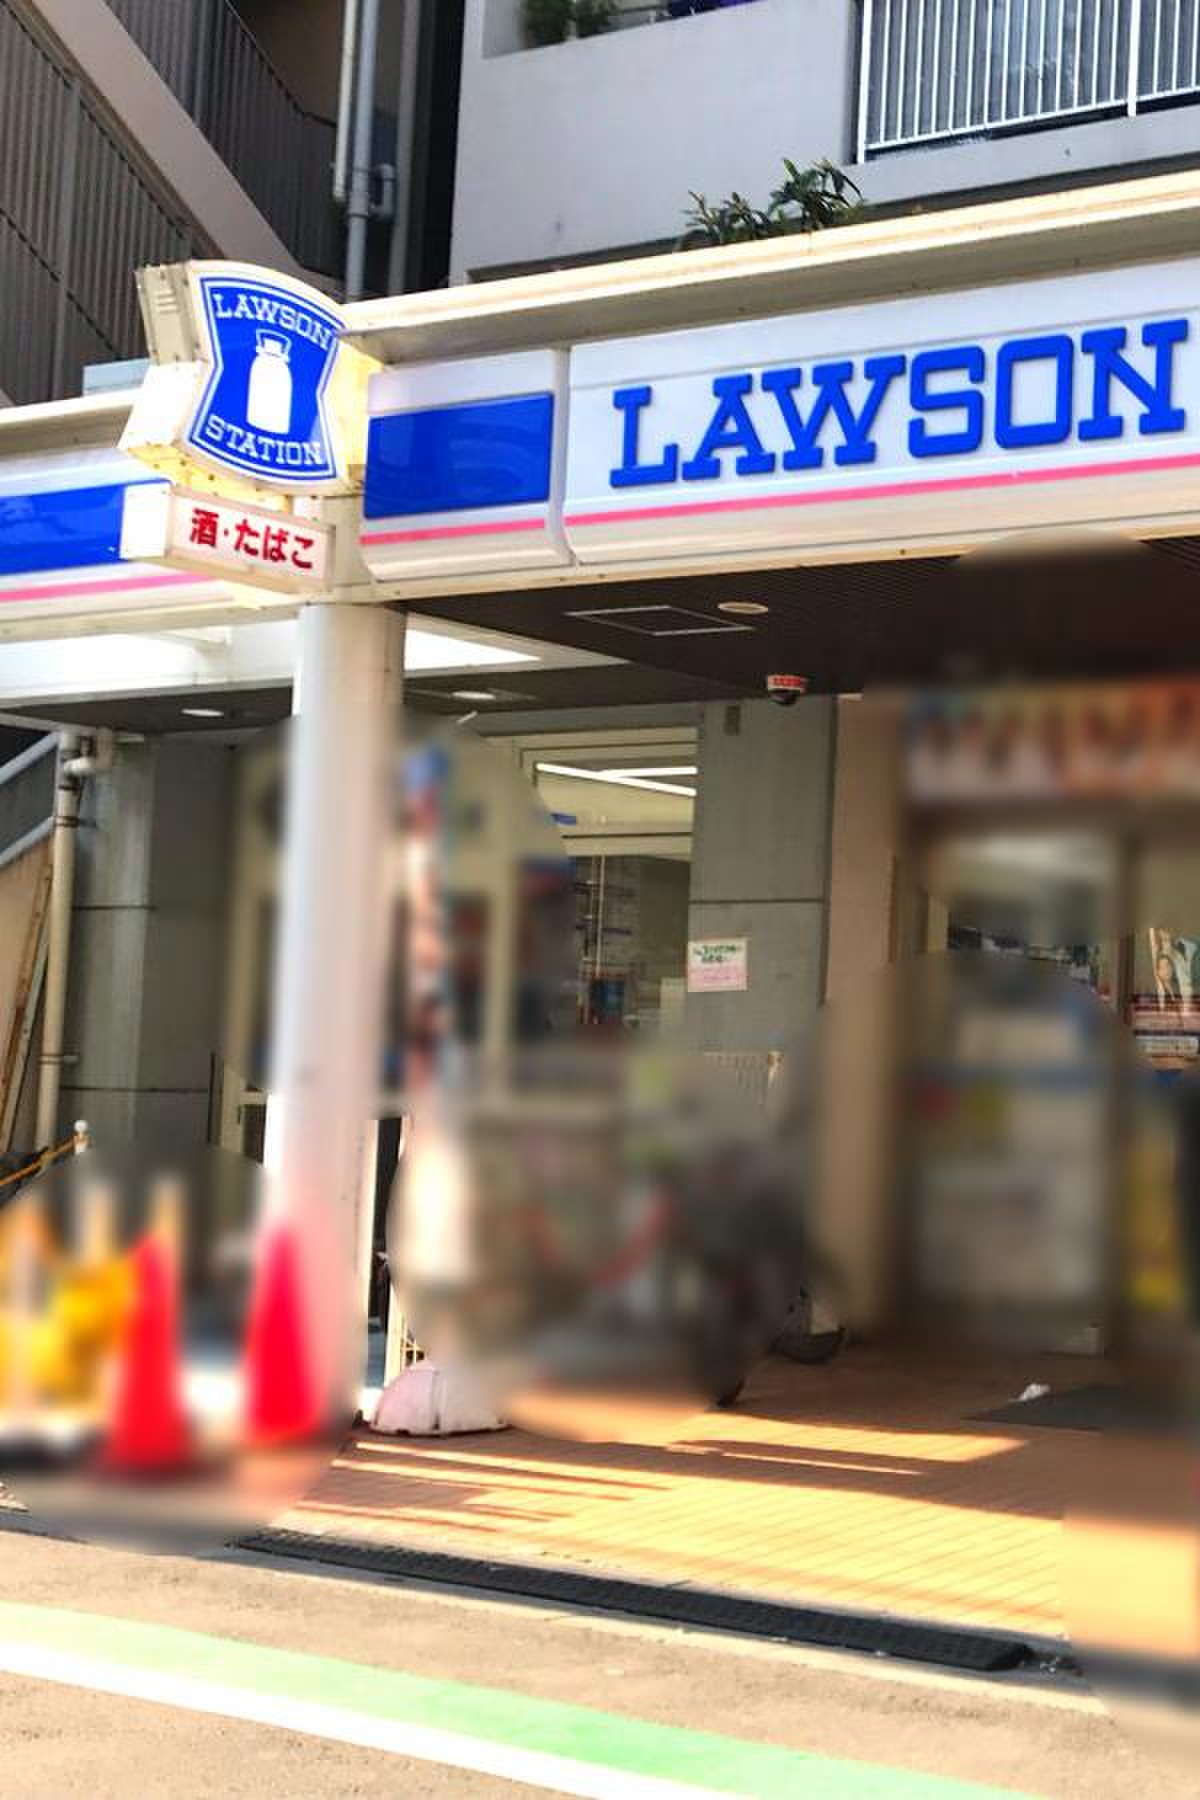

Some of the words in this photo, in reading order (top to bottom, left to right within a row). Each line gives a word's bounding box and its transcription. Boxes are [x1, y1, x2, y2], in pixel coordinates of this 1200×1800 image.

[213, 293, 334, 351] LAWSON
[609, 317, 1189, 488] LAWSON
[206, 416, 326, 466] STATION
